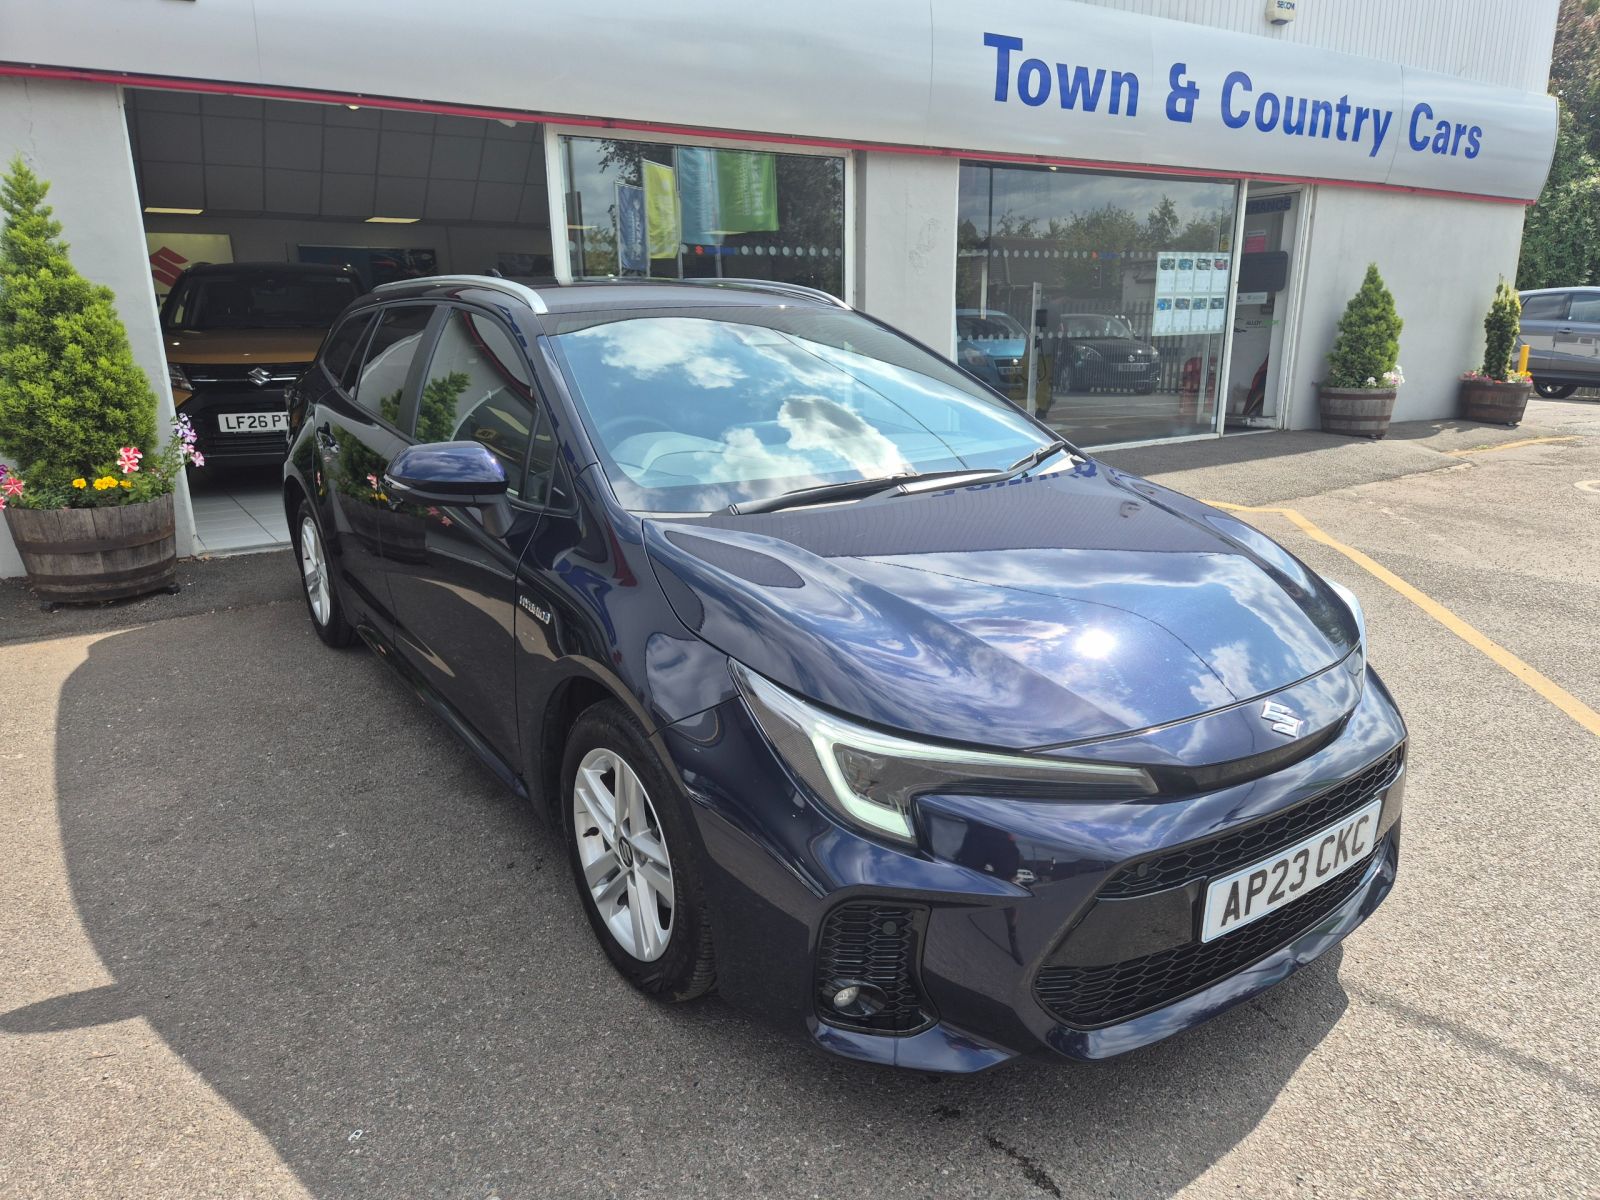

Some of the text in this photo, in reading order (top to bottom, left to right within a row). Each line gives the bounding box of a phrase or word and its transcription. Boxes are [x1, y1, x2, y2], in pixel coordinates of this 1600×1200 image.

[983, 32, 1483, 161] Town & Country Cars
[225, 415, 268, 430] LF26
[1220, 814, 1370, 927] AP23 CKC
